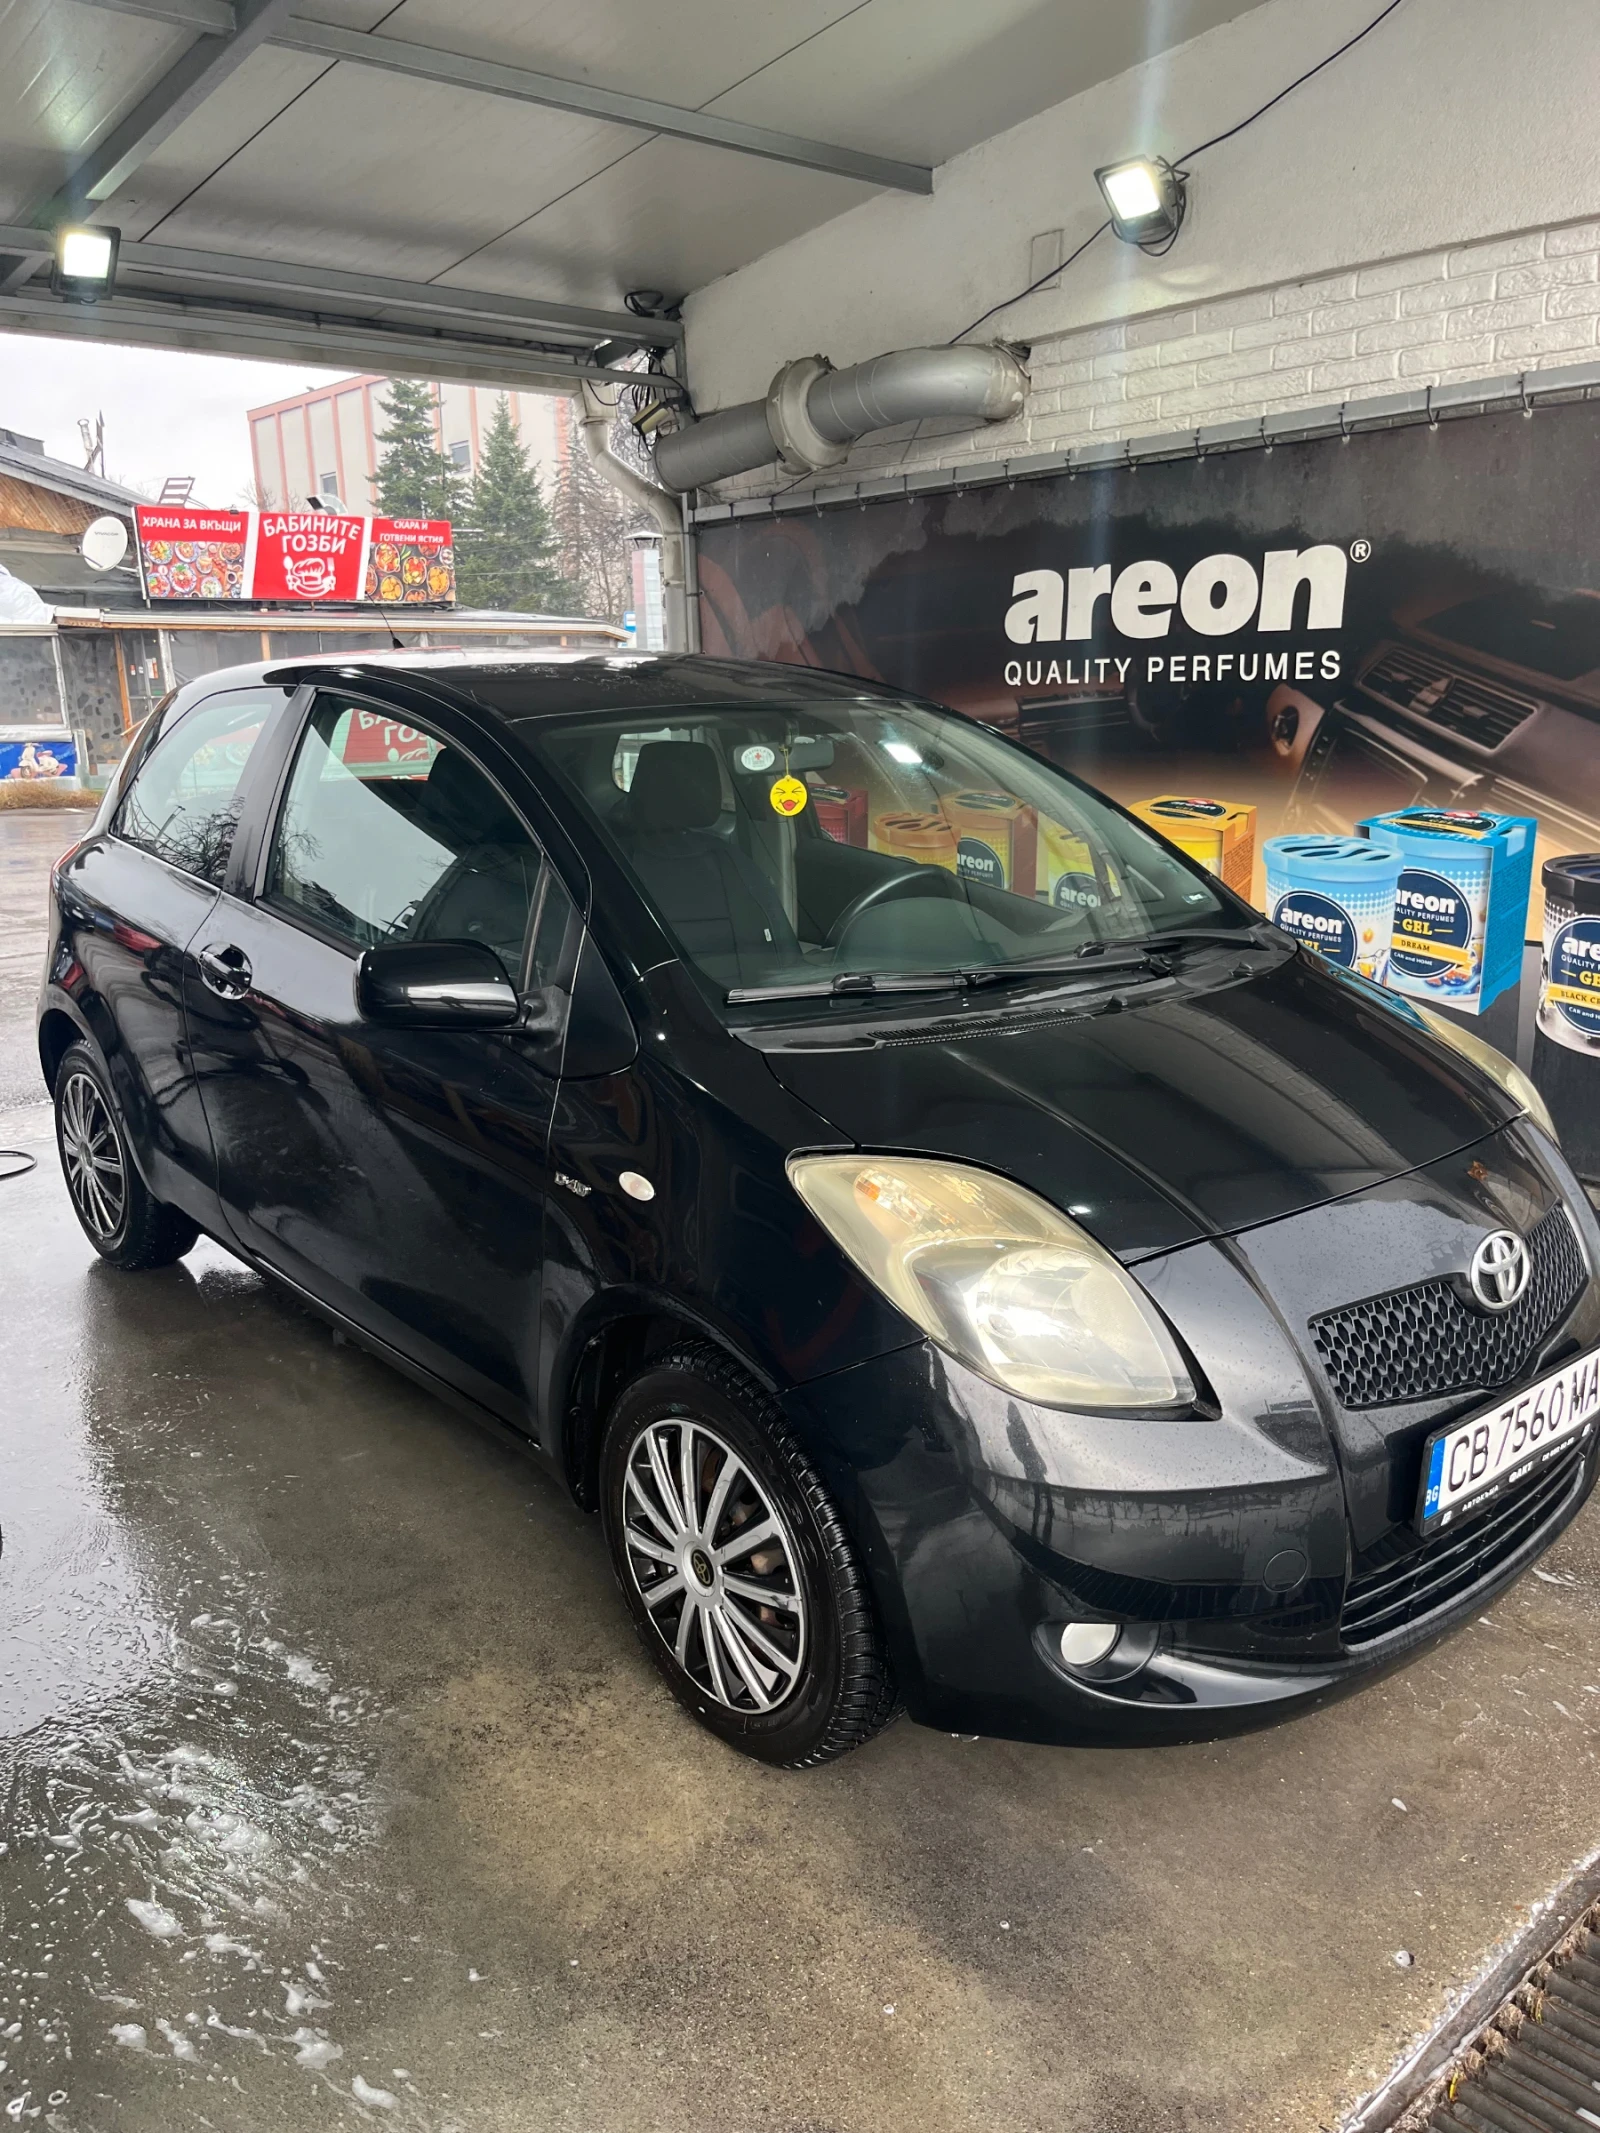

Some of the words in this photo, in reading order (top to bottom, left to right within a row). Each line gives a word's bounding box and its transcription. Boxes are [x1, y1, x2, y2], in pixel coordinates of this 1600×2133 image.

[142, 516, 181, 528] ХРАНА
[183, 518, 197, 529] ЗА
[199, 519, 241, 534] ВКЪЩИ
[263, 515, 361, 540] БАБИНИТЕ
[393, 521, 420, 529] СКАРА
[421, 522, 429, 530] И
[282, 534, 347, 554] ГОЗБИ
[380, 533, 417, 542] ГОТВЕНИ
[418, 535, 444, 543] ЯСТИЯ
[1004, 657, 1132, 686] QUALITY
[1147, 650, 1341, 683] PERFUMES
[1280, 907, 1343, 934] areon
[1396, 907, 1416, 917] ALITY
[1417, 911, 1455, 923] PERFUMES
[1280, 923, 1307, 936] QUALITY
[1307, 931, 1342, 942] PERFUMES
[1402, 918, 1433, 936] GEL
[1401, 939, 1430, 952] DREAM
[1561, 936, 1600, 961] are
[1393, 951, 1405, 959] CAR
[1416, 958, 1433, 966] HOME
[1561, 954, 1595, 970] QUALITY
[1579, 970, 1600, 987] GE
[1560, 990, 1588, 1003] BLACK
[1568, 1006, 1581, 1014] CAR
[1448, 1424, 1490, 1492] CB
[1494, 1380, 1564, 1468] 7560
